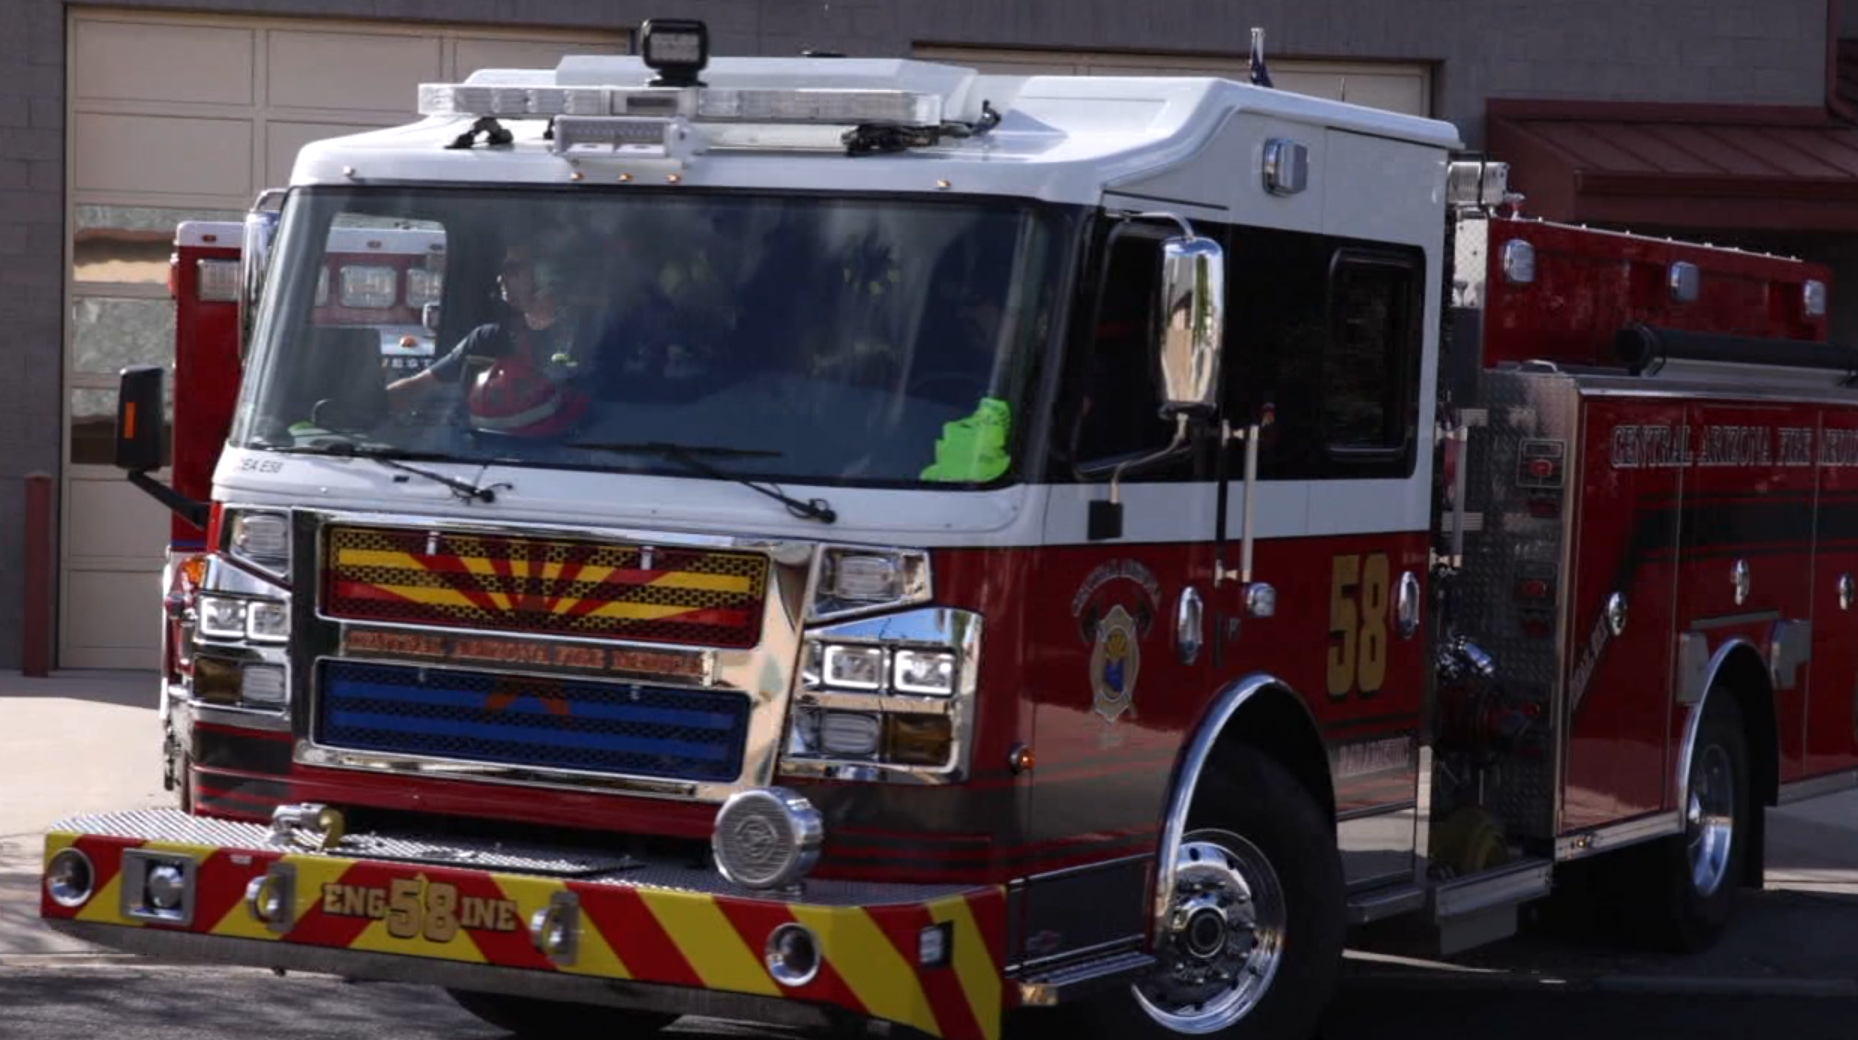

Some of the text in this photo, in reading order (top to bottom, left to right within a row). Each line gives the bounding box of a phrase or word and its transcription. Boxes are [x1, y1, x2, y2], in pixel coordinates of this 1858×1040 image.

[1611, 425, 1693, 467] CENTRAL
[1697, 425, 1773, 467] ARIZONA
[1777, 427, 1813, 467] FIRE
[346, 630, 446, 657] CENTRAL
[451, 638, 549, 665] ARIZONA
[553, 645, 606, 669] FIRE
[1326, 553, 1390, 698] 58
[385, 878, 459, 943] 58
